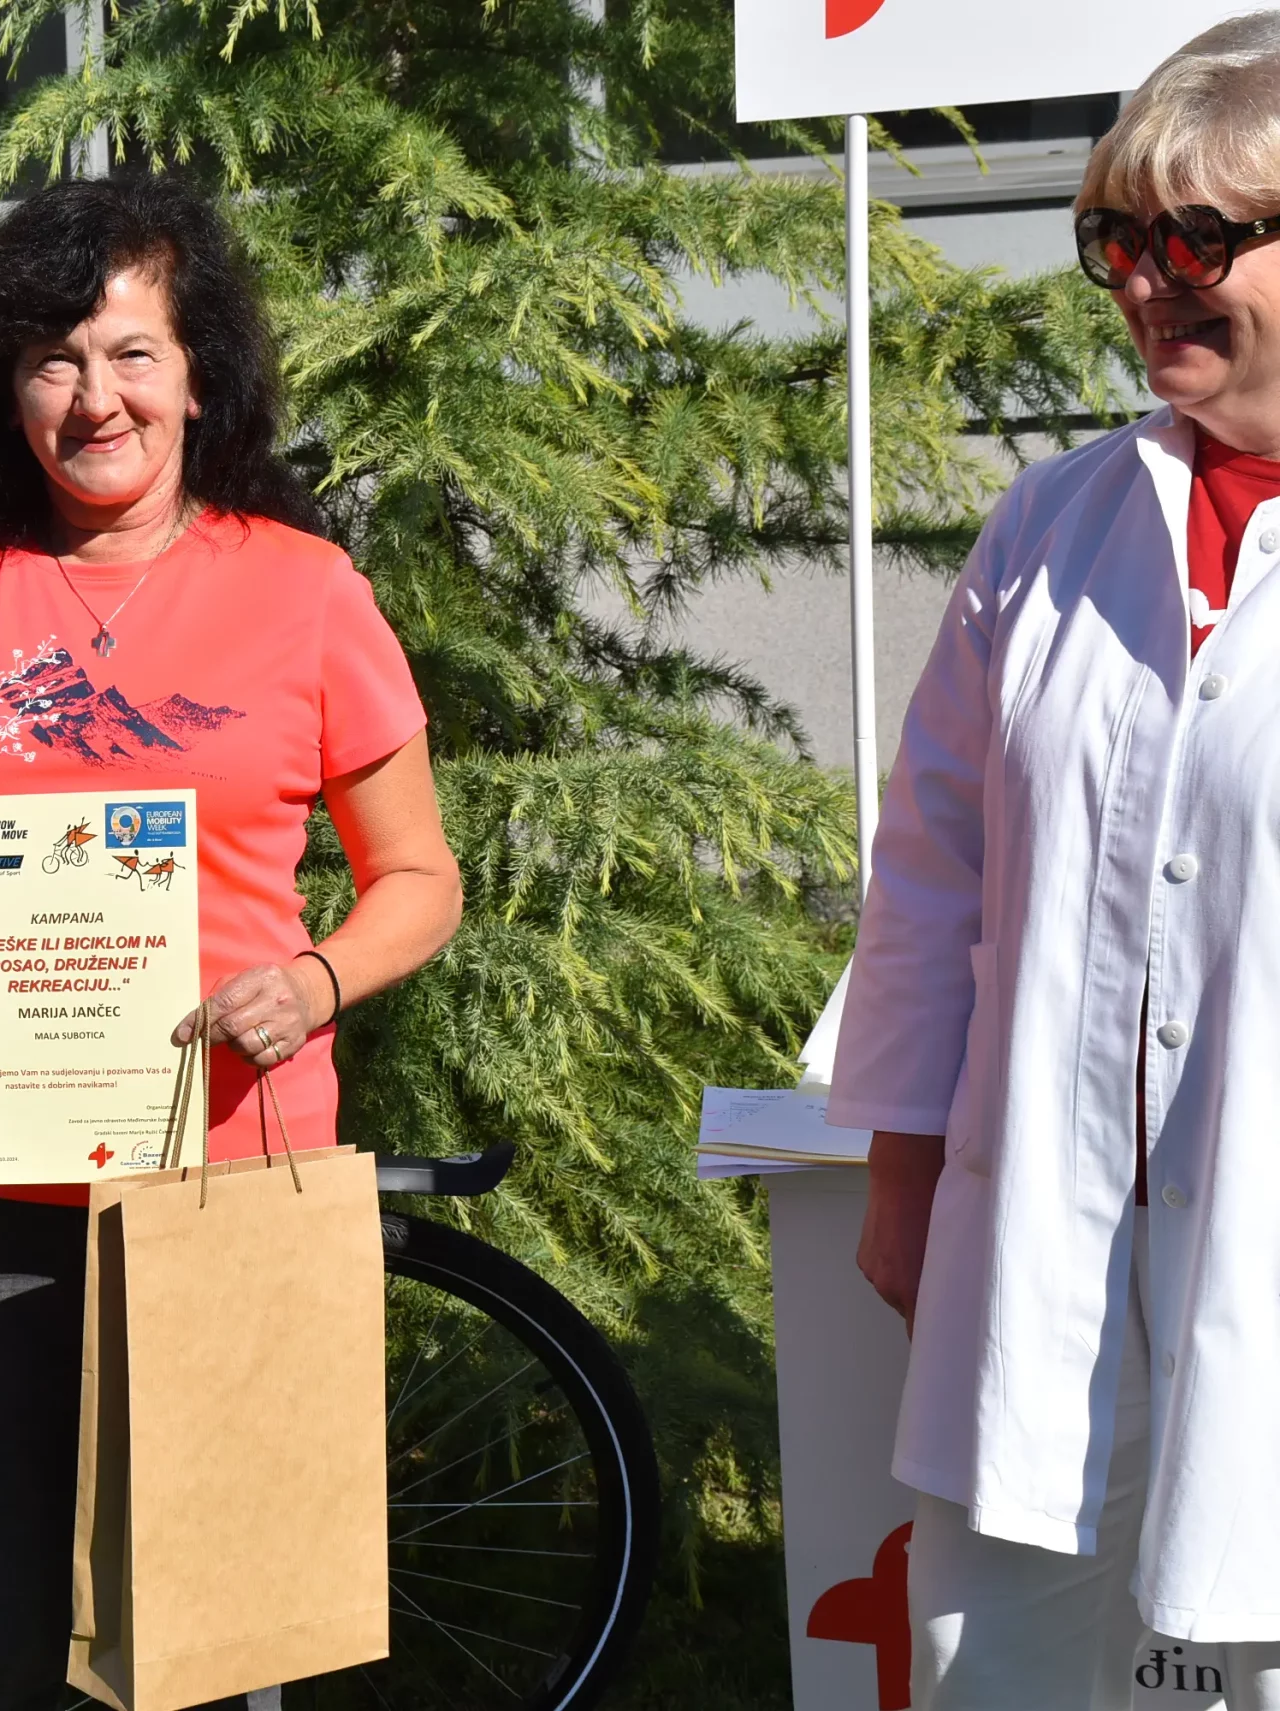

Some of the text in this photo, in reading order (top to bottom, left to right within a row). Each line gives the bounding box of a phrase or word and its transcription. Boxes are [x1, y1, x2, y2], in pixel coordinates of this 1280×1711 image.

[146, 817, 182, 825] MOBILITY
[1, 830, 29, 840] MOVE
[30, 911, 104, 925] KAMPANJA
[41, 938, 59, 951] ILI
[64, 935, 140, 950] BICIKLOM
[144, 935, 167, 949] NA
[54, 955, 138, 972] DRUŽENJE
[141, 956, 148, 970] I
[18, 1003, 121, 1019] MARIJA JANČEC
[34, 1031, 105, 1040] MALA SUBOTICA
[51, 1068, 100, 1077] sudjelovanju
[106, 1068, 144, 1076] pozivamo
[47, 1081, 75, 1089] dobrim
[77, 1080, 118, 1088] navikama!
